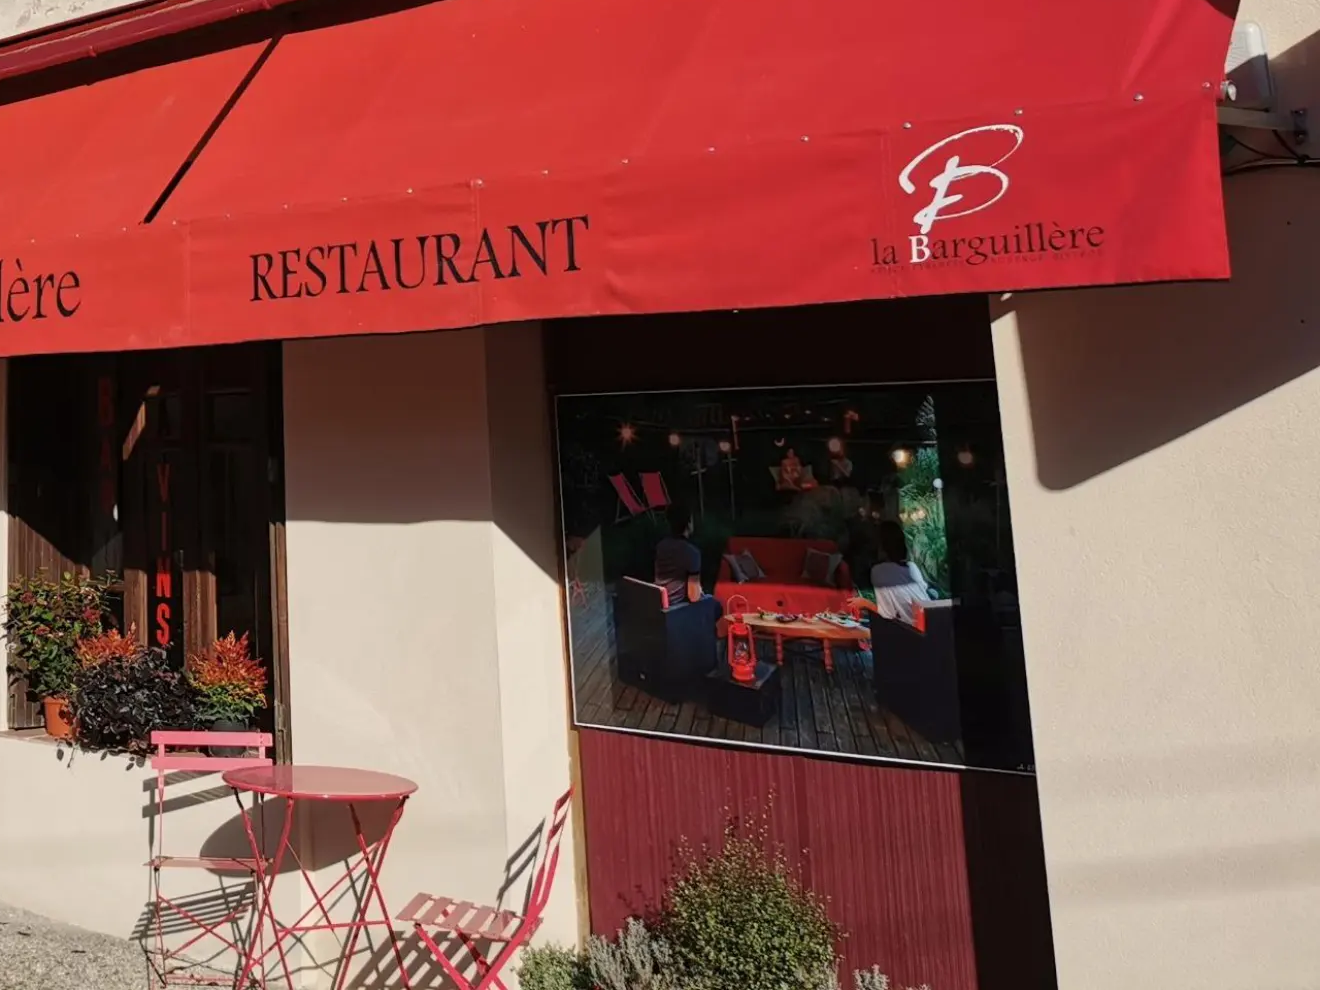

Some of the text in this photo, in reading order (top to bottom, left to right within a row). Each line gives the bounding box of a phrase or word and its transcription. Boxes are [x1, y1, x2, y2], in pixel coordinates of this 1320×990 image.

[249, 213, 589, 302] RESTAURANT
[870, 237, 898, 266] la
[908, 221, 1105, 266] Barguillère
[155, 462, 173, 646] VINS
